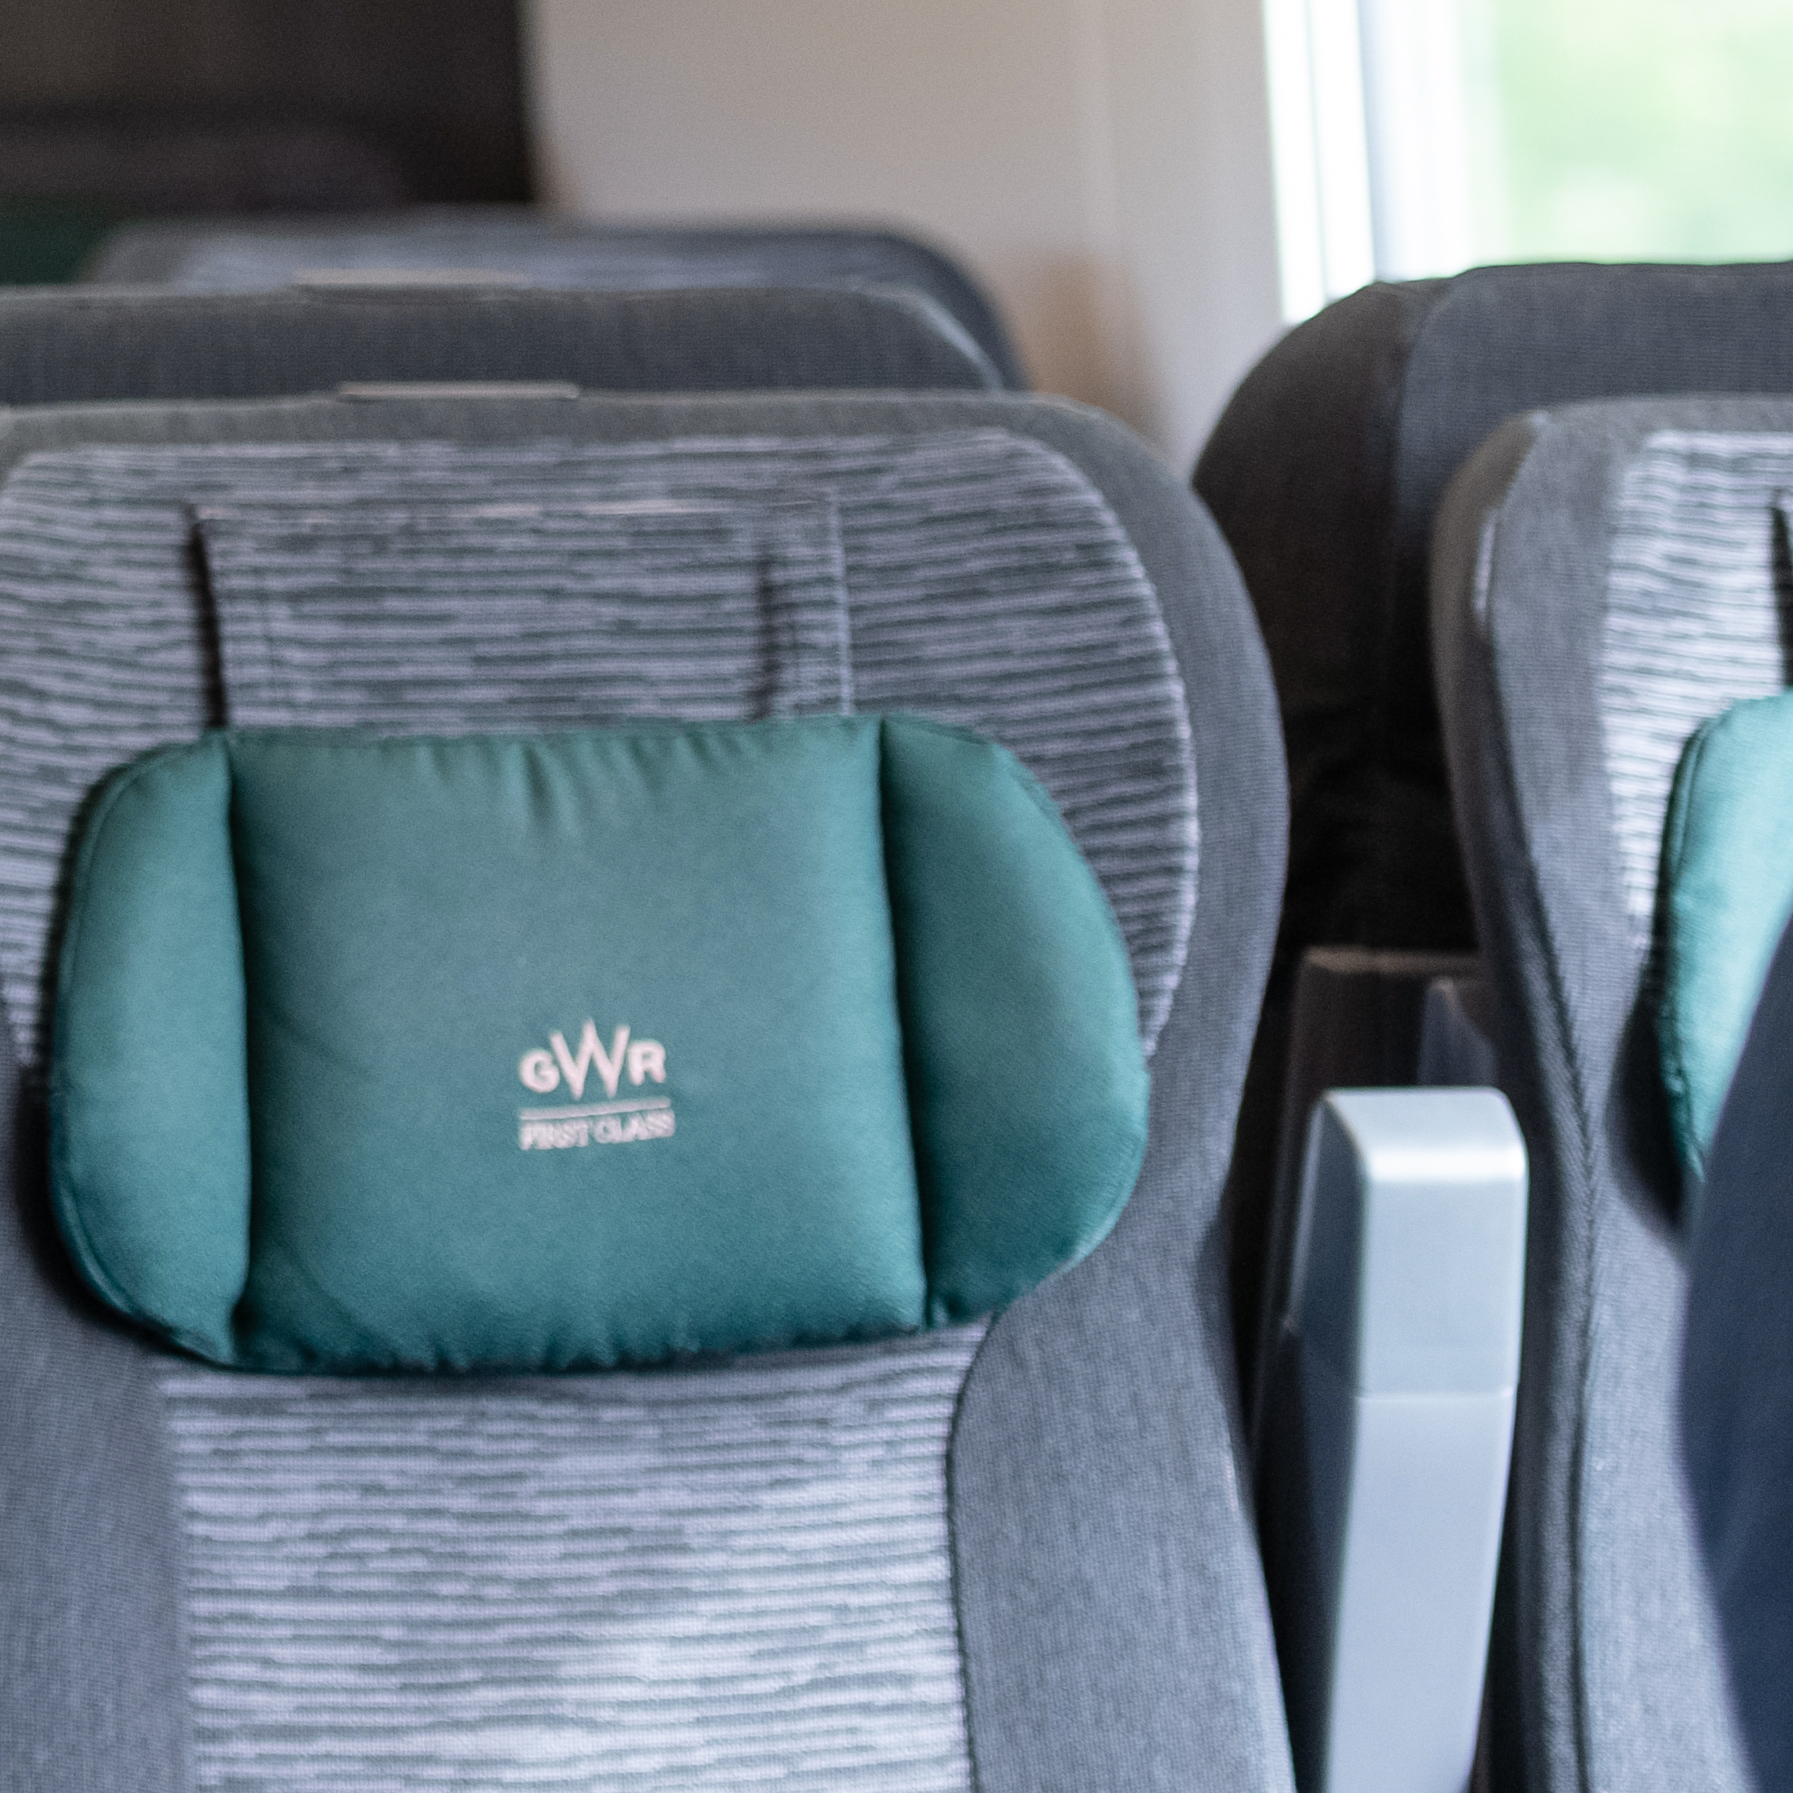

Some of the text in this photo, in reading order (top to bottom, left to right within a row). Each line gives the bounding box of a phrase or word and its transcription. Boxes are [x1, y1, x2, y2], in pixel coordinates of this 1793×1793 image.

[519, 1017, 666, 1101] GWR
[519, 1108, 676, 1151] FIRST CLASS
